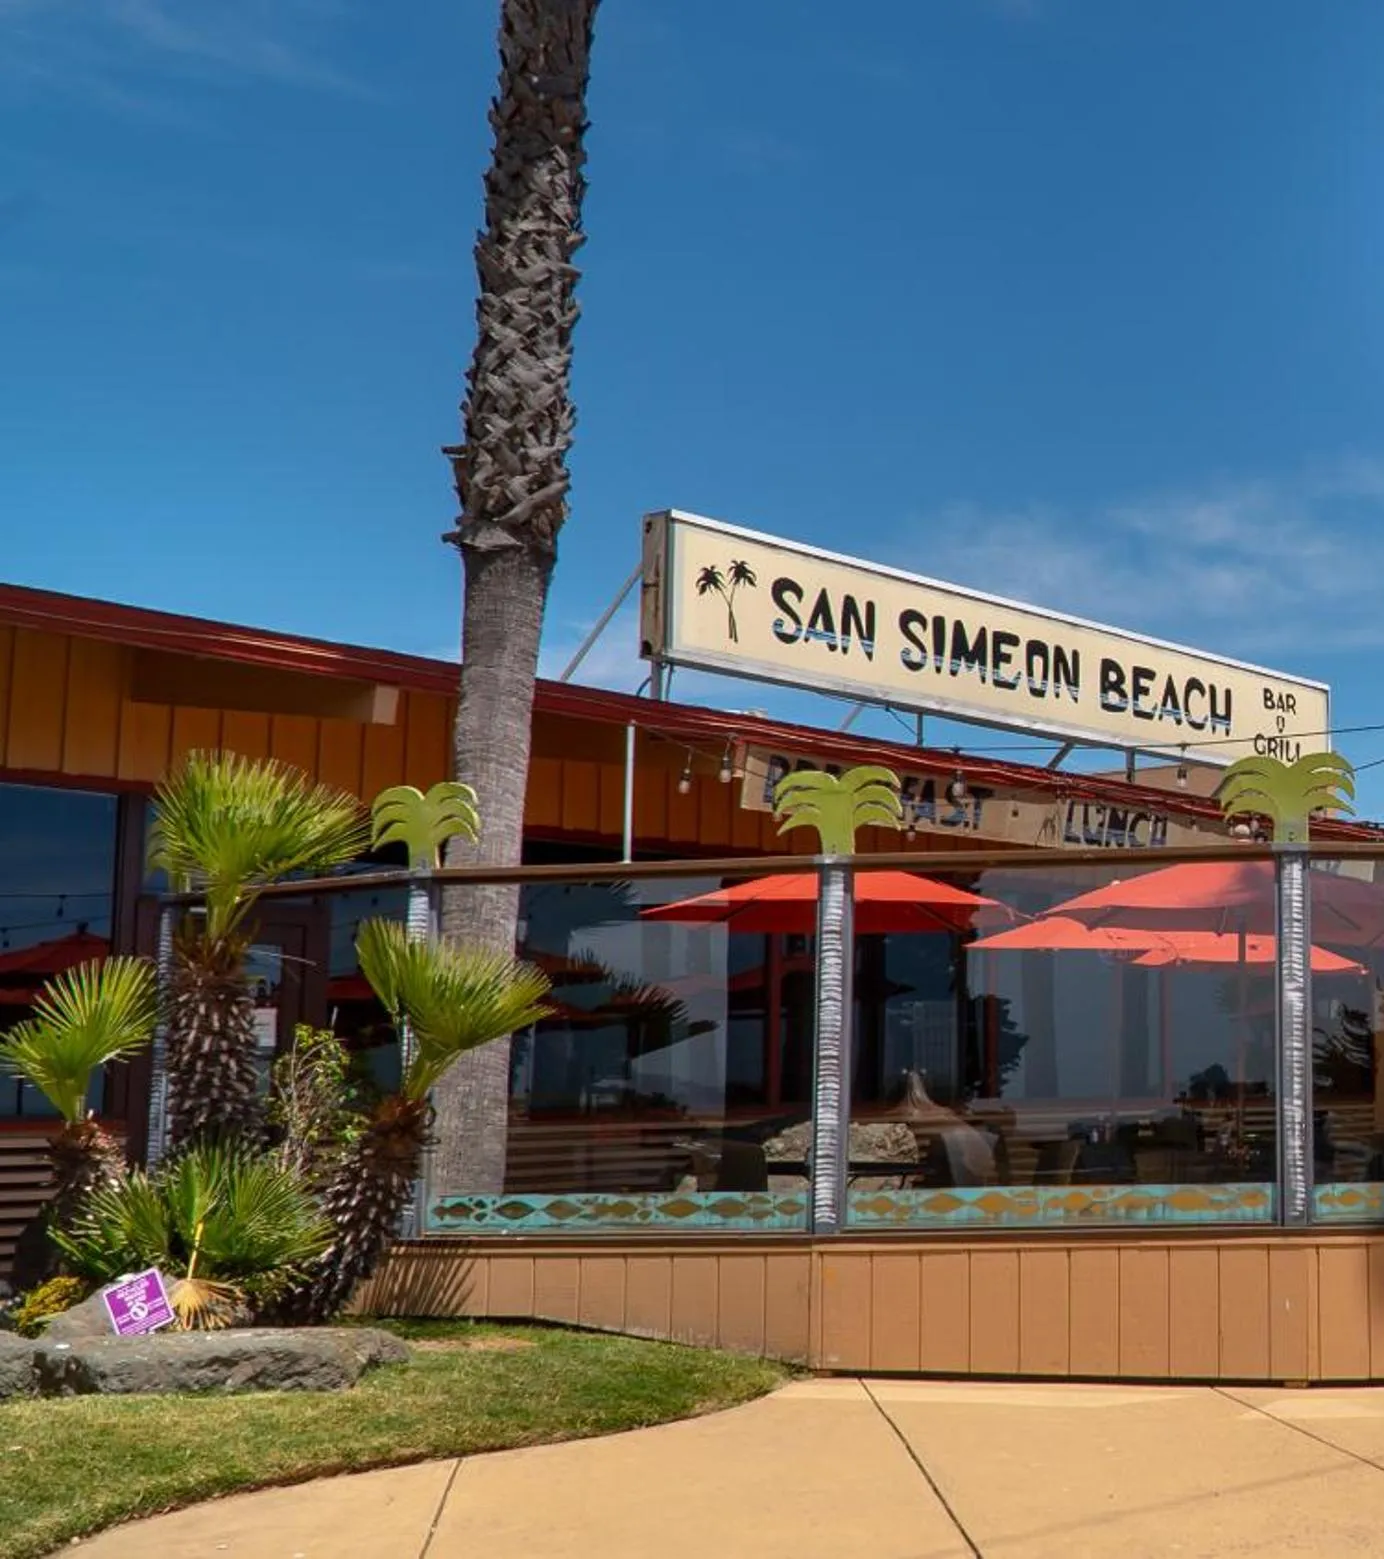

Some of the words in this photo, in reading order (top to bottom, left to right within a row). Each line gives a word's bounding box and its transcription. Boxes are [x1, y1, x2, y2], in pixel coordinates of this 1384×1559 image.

[771, 577, 876, 662] SAN
[899, 609, 1080, 704] SIMEON
[1100, 658, 1233, 738] BEACH
[1263, 687, 1297, 715] BAR
[1063, 801, 1168, 848] LUNCH
